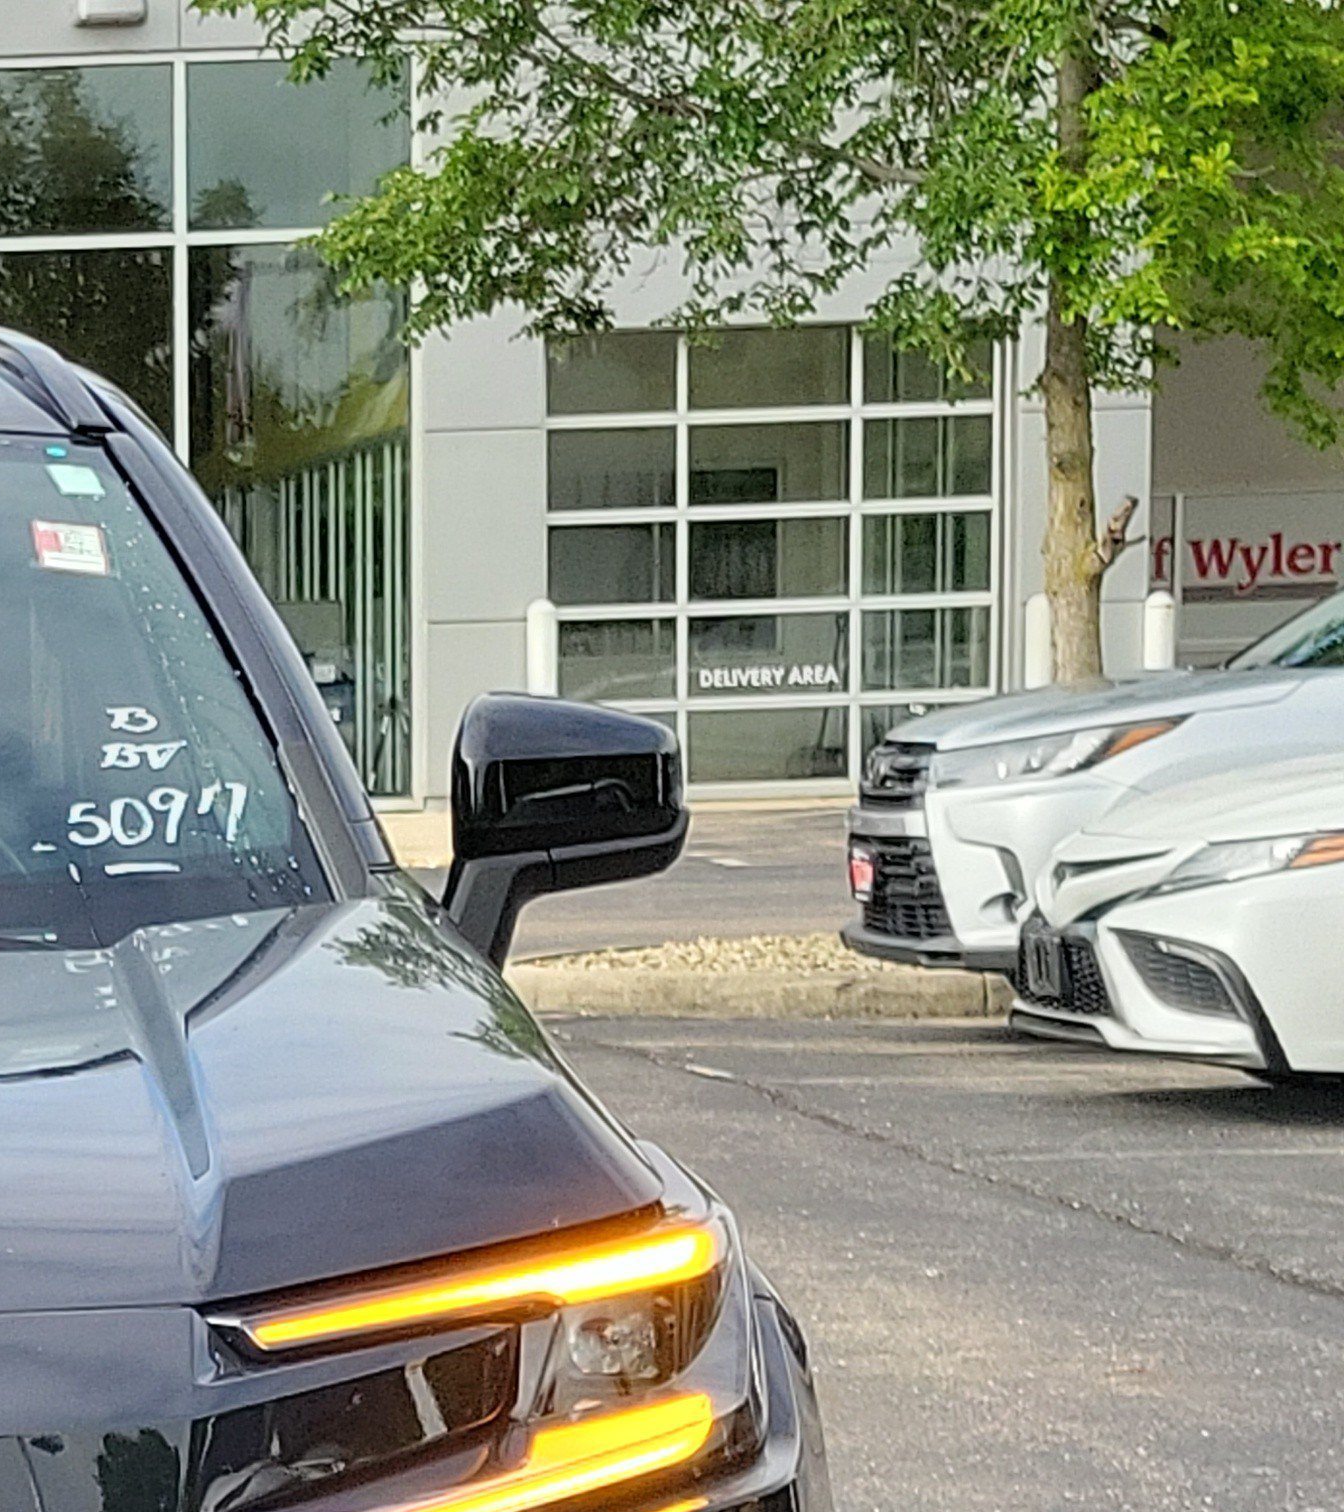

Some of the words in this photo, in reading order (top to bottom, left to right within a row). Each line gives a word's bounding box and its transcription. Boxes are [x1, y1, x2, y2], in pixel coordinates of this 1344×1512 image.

[1187, 532, 1342, 591] Wyler
[699, 666, 785, 688] DELIVERY
[787, 663, 839, 685] AREA
